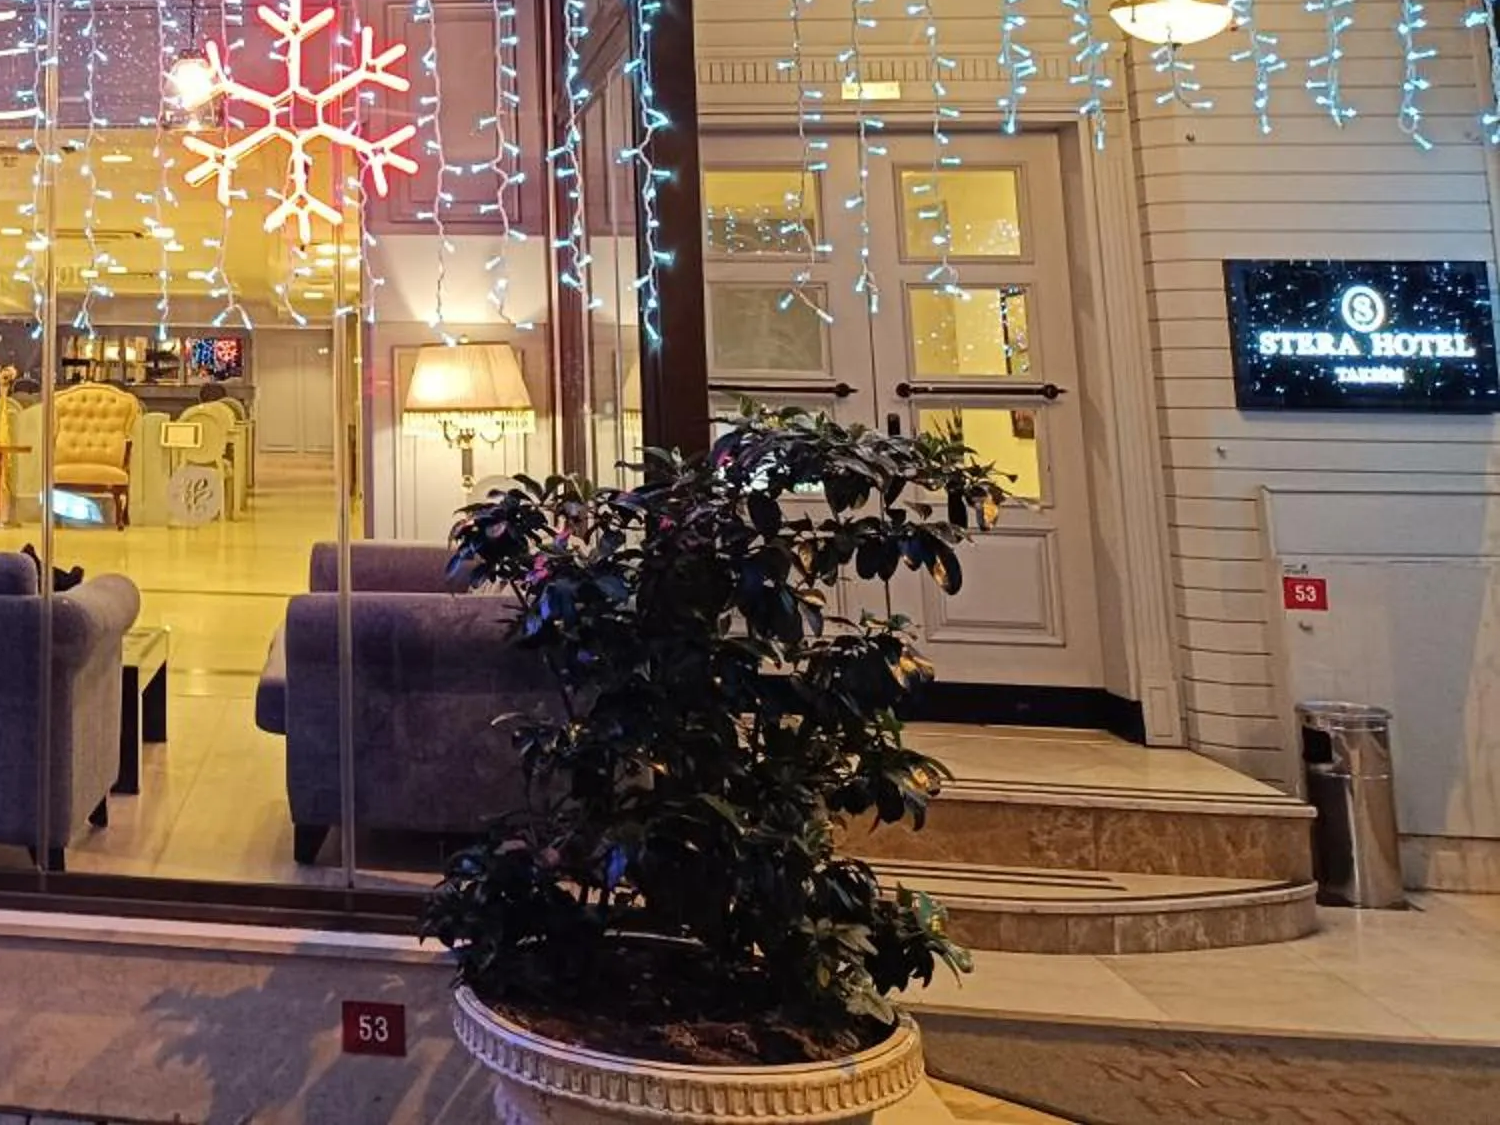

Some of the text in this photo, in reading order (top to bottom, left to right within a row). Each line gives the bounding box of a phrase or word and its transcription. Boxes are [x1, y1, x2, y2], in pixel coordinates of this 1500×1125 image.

[1259, 331, 1476, 357] STERA HOTEL
[1295, 584, 1317, 602] 53
[358, 1014, 390, 1043] 53
